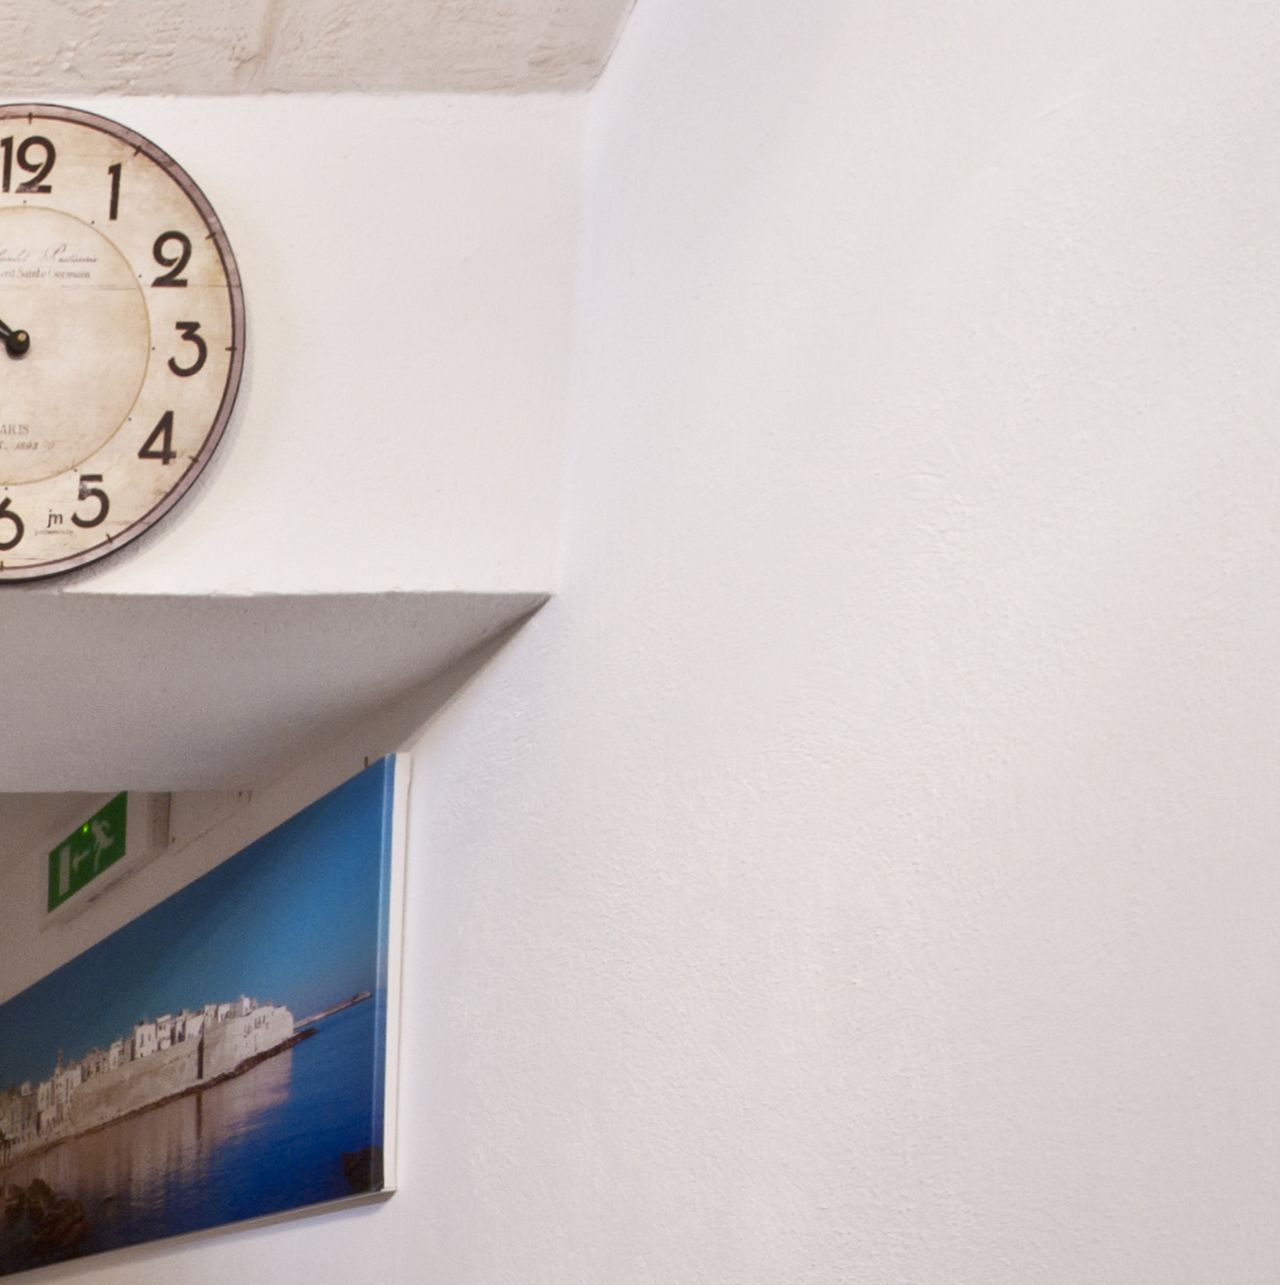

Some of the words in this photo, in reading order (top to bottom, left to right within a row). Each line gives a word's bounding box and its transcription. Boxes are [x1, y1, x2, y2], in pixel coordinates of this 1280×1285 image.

[0, 135, 56, 194] 12
[108, 162, 122, 221] 1
[151, 230, 192, 288] 2
[167, 321, 208, 378] 3
[137, 410, 177, 466] 4
[71, 474, 110, 529] 5
